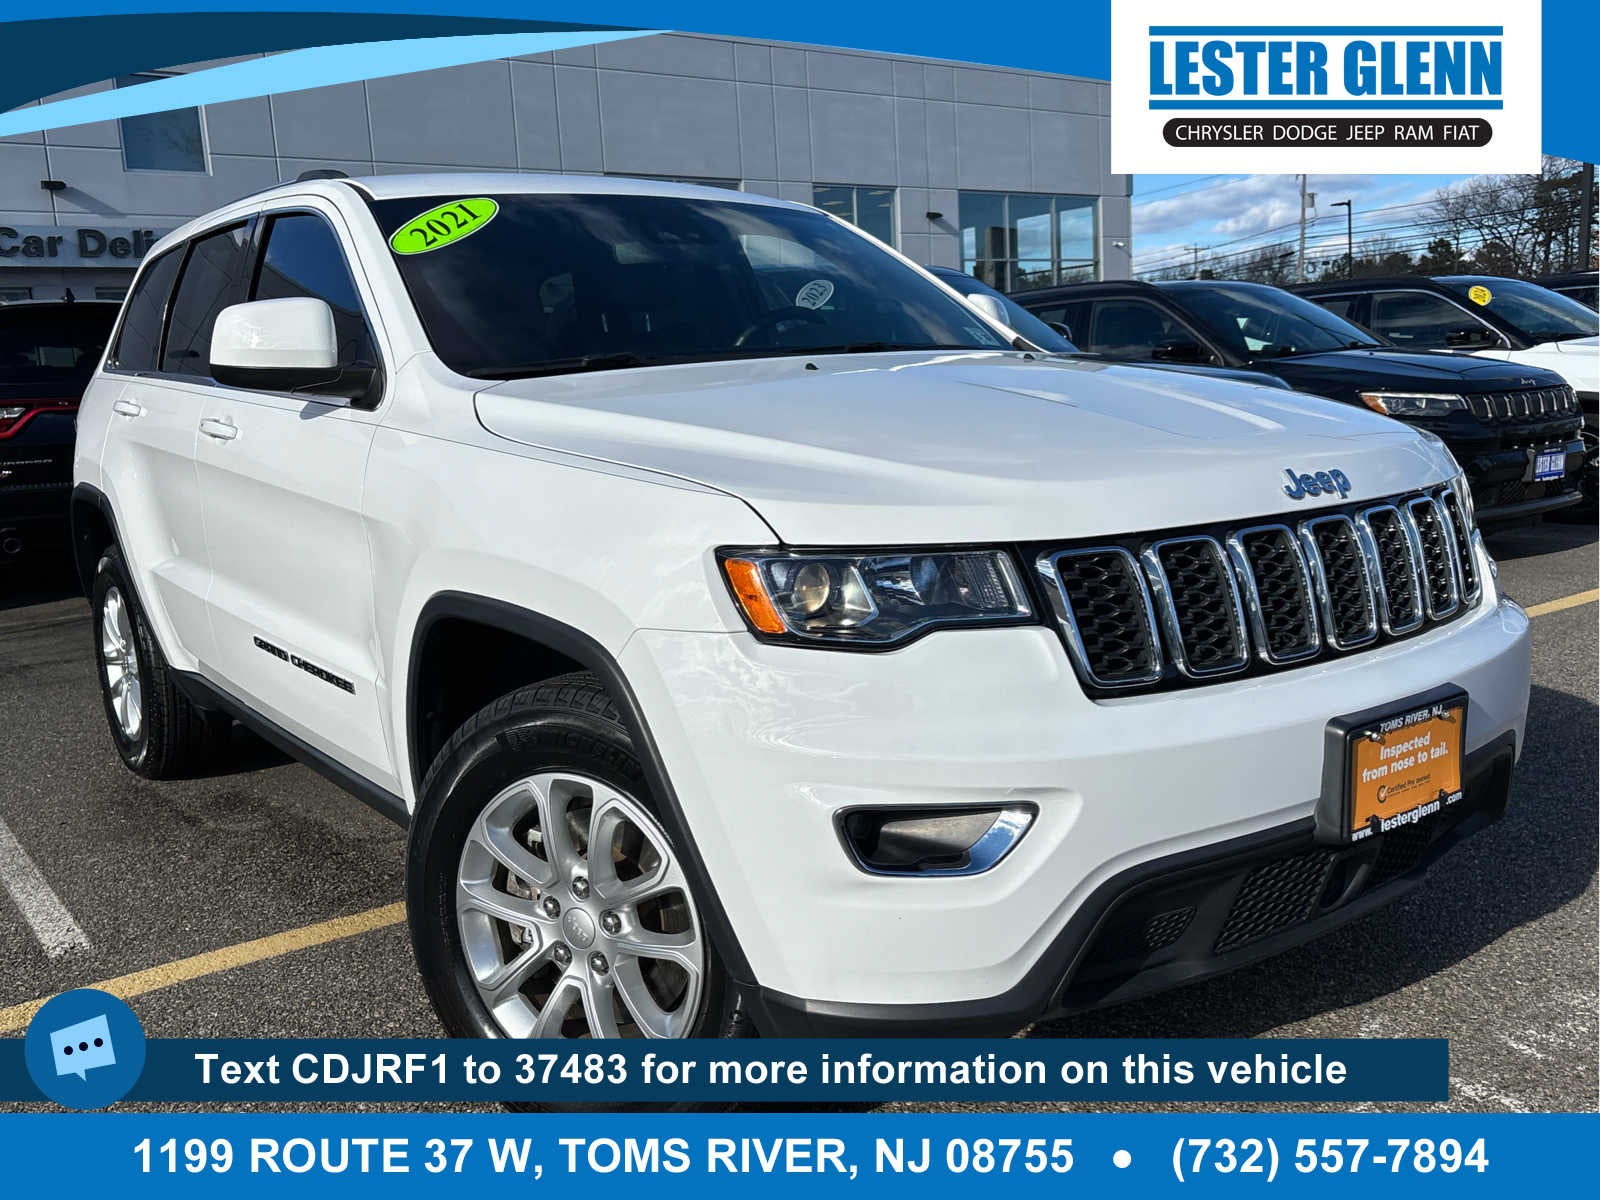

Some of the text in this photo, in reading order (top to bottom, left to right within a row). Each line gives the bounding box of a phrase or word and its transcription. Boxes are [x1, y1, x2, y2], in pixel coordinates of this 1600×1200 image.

[410, 204, 480, 247] 2021
[0, 227, 63, 258] Car
[1284, 468, 1352, 500] Jeep
[1380, 718, 1403, 733] TOMS
[1380, 731, 1431, 760] Inspected
[1362, 741, 1449, 783] from nose to tail.
[1381, 800, 1440, 832] lesterglenn
